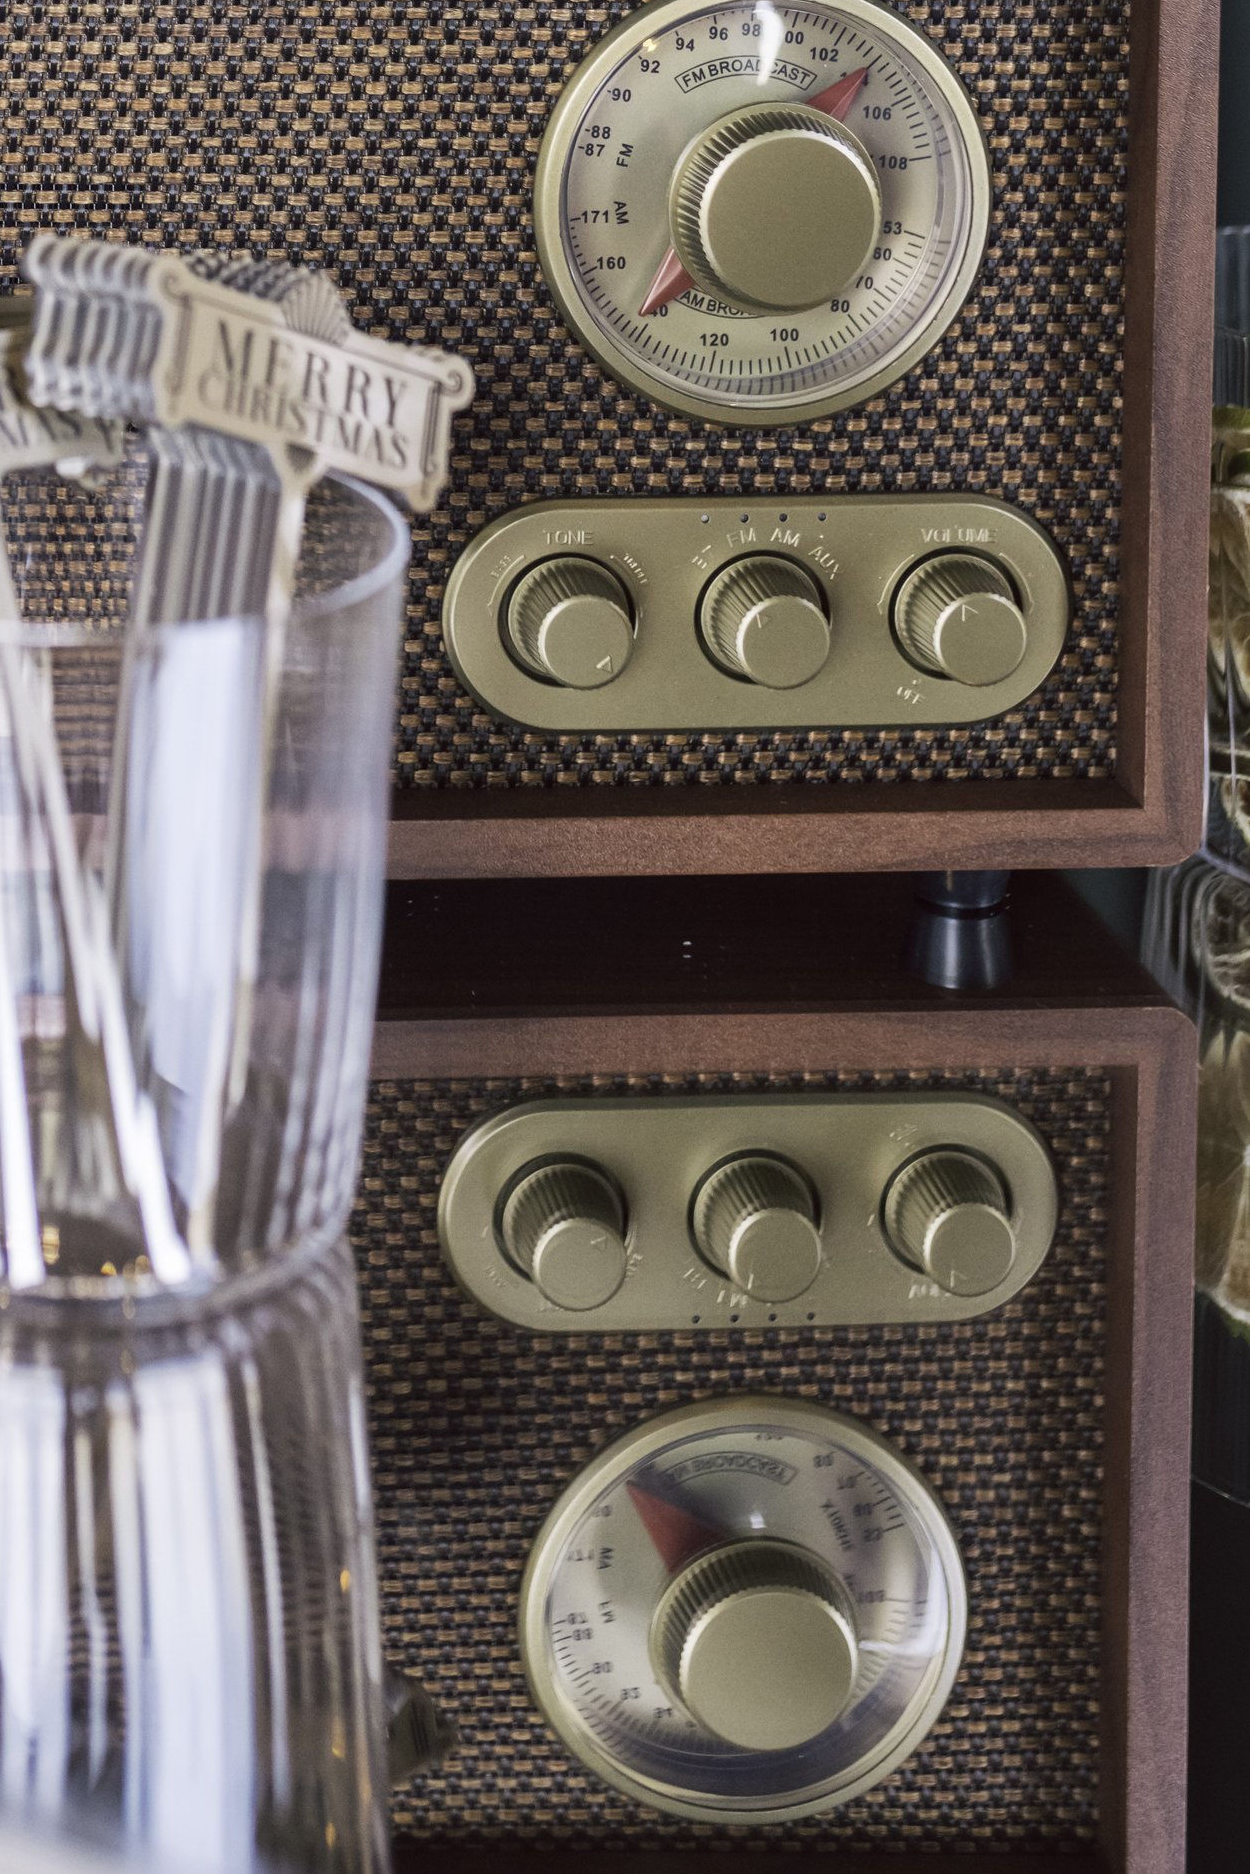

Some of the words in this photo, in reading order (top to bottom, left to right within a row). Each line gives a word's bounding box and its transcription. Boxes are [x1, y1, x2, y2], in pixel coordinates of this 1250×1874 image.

[708, 26, 729, 41] 96
[741, 22, 762, 37] 98
[778, 30, 805, 45] 00
[675, 37, 695, 52] 94
[809, 46, 839, 63] 102
[639, 58, 661, 74] 92
[682, 67, 706, 88] FM
[611, 87, 632, 103] 90
[862, 105, 893, 121] 106
[590, 125, 611, 140] 88
[584, 143, 605, 158] 87
[616, 142, 634, 168] FM
[878, 154, 908, 170] 108
[580, 210, 609, 224] 171
[614, 200, 630, 225] AM
[882, 220, 903, 236] 53
[872, 246, 892, 261] 60
[596, 255, 626, 270] 160
[854, 275, 874, 290] 70
[680, 289, 705, 310] AM
[830, 298, 850, 314] 80
[699, 332, 729, 347] 120
[769, 327, 799, 342] 100
[211, 319, 408, 427] MERRY
[198, 374, 408, 470] CHRISTMAS
[542, 529, 594, 546] TONE
[726, 527, 757, 548] FM
[769, 527, 801, 548] AM
[920, 527, 999, 544] VOLUME
